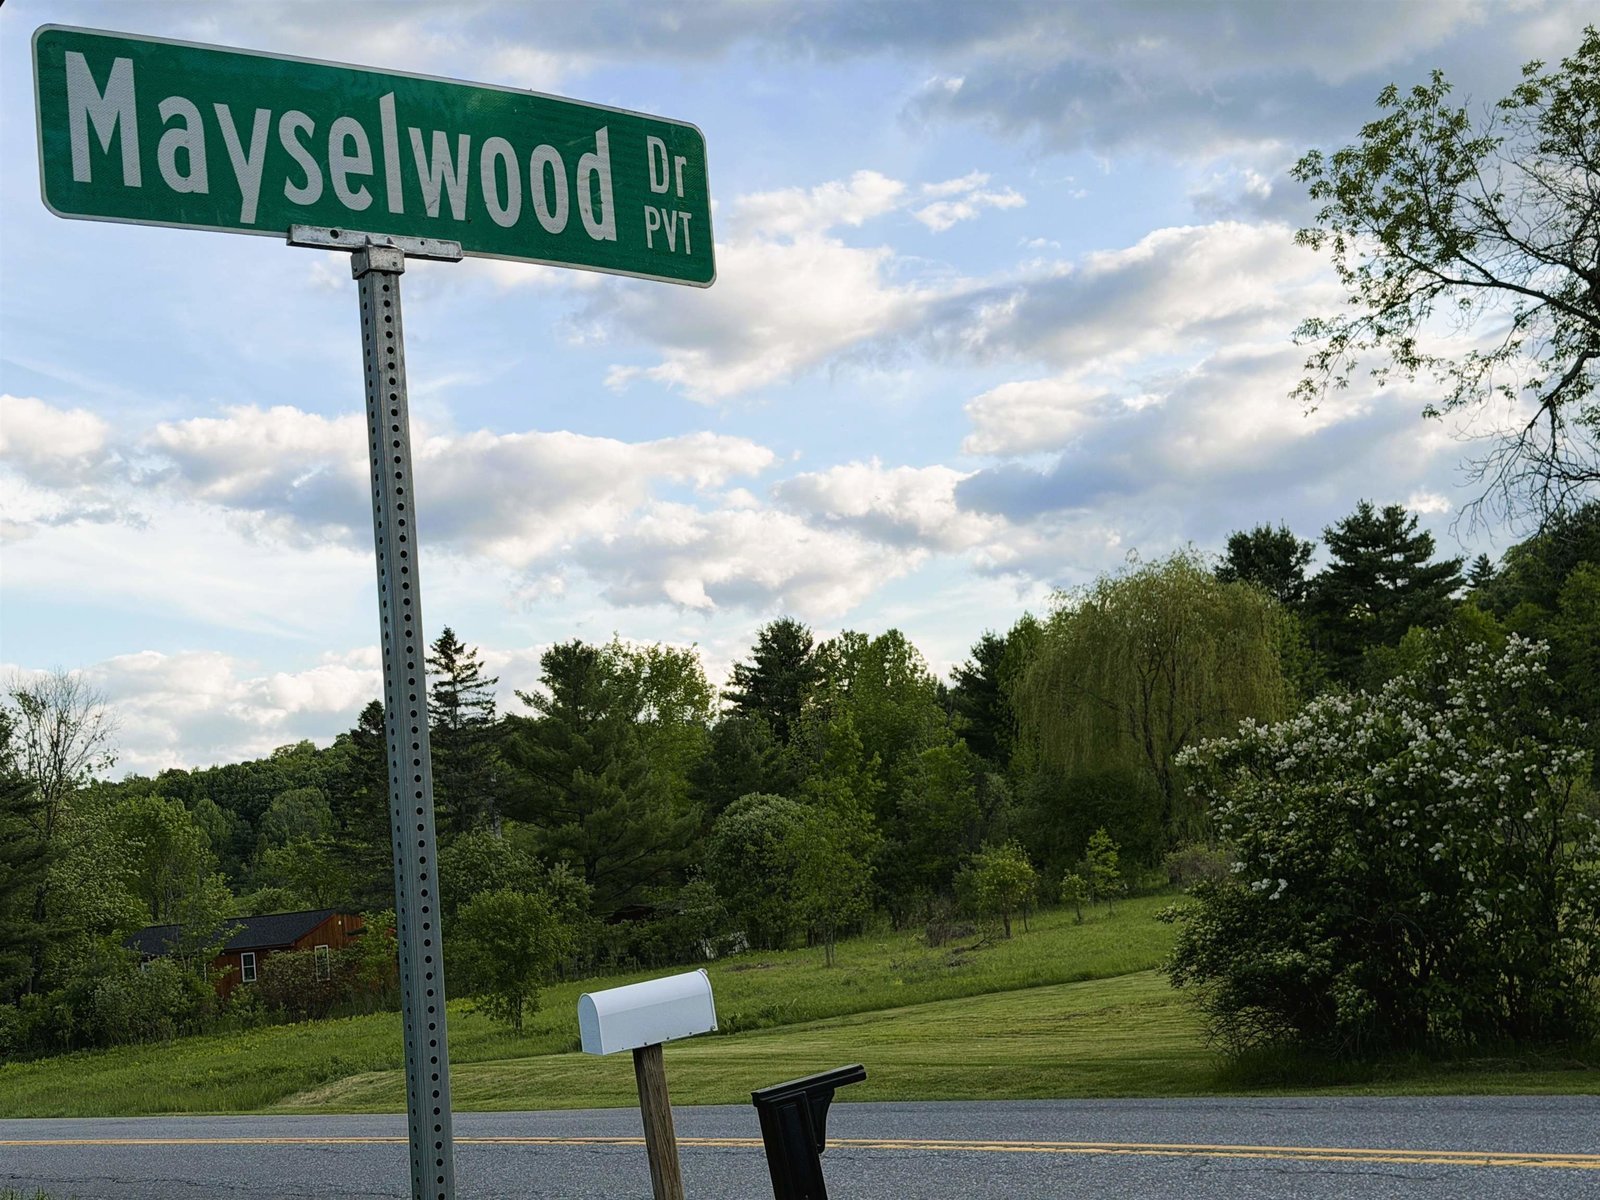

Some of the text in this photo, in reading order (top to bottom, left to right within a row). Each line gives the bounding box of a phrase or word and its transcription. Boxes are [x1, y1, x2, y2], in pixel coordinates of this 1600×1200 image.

[65, 51, 687, 242] Mayselwood Dr
[644, 205, 692, 255] PVT
